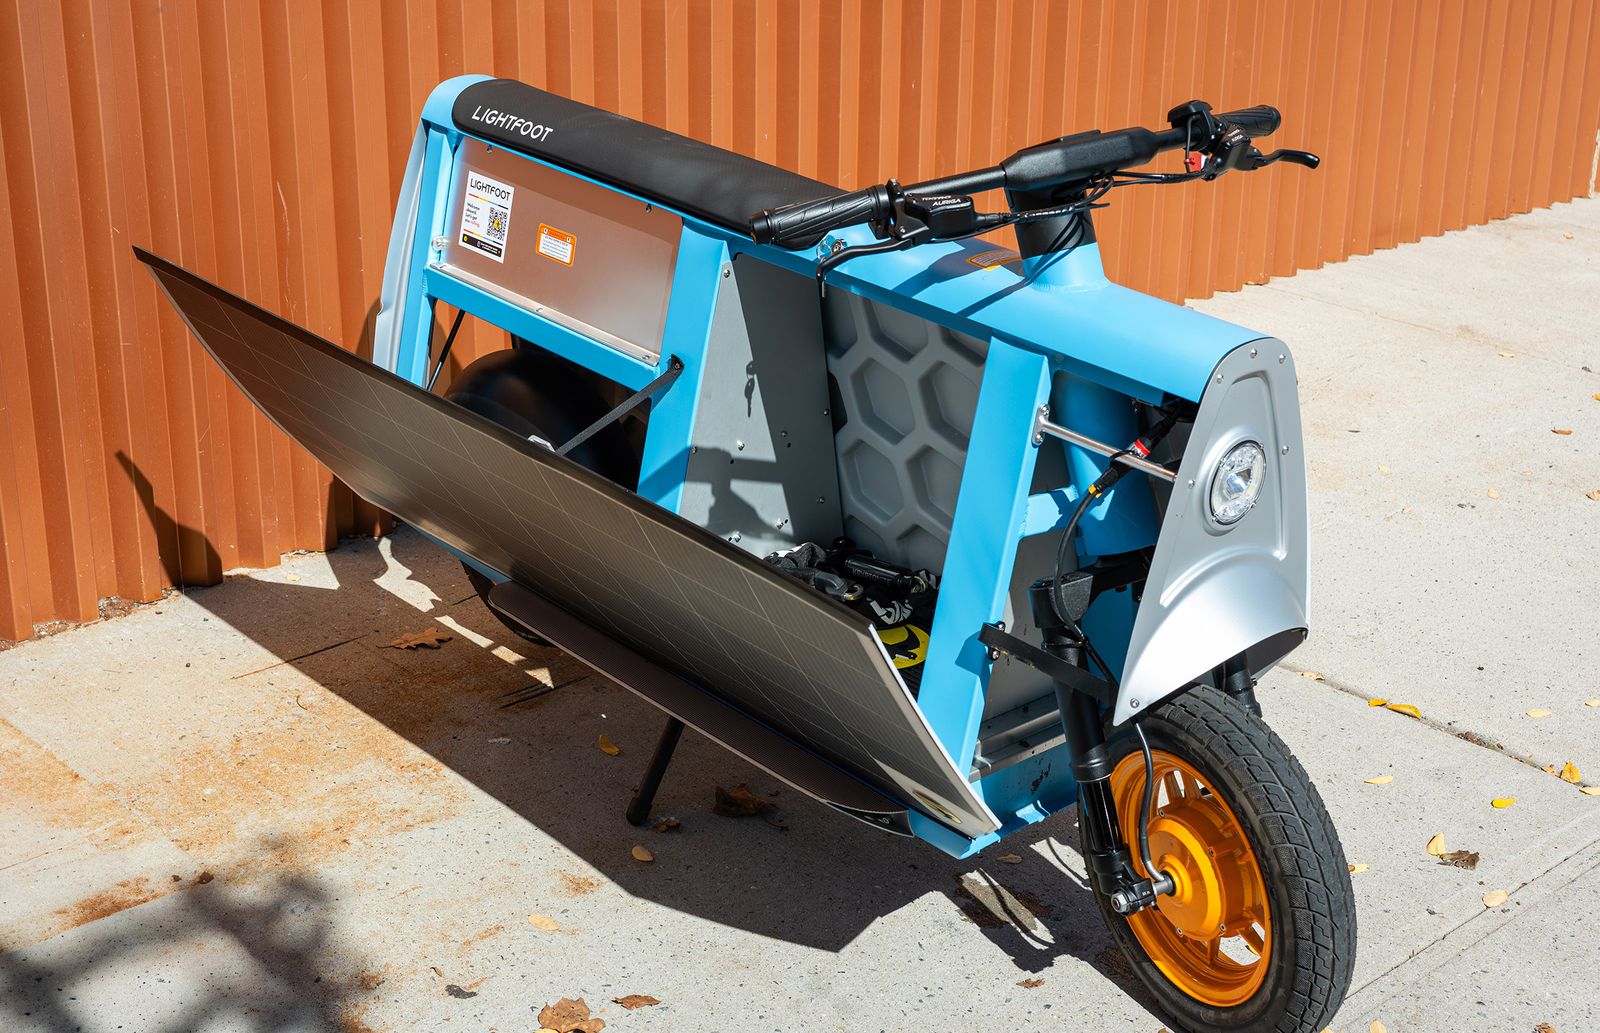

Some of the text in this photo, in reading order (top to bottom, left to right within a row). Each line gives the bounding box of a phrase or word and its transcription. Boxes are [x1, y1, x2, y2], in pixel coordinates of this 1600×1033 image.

[472, 105, 553, 142] LIGHTFOOT
[470, 178, 511, 201] LIGHTFOOT
[932, 198, 961, 206] AURIGA
